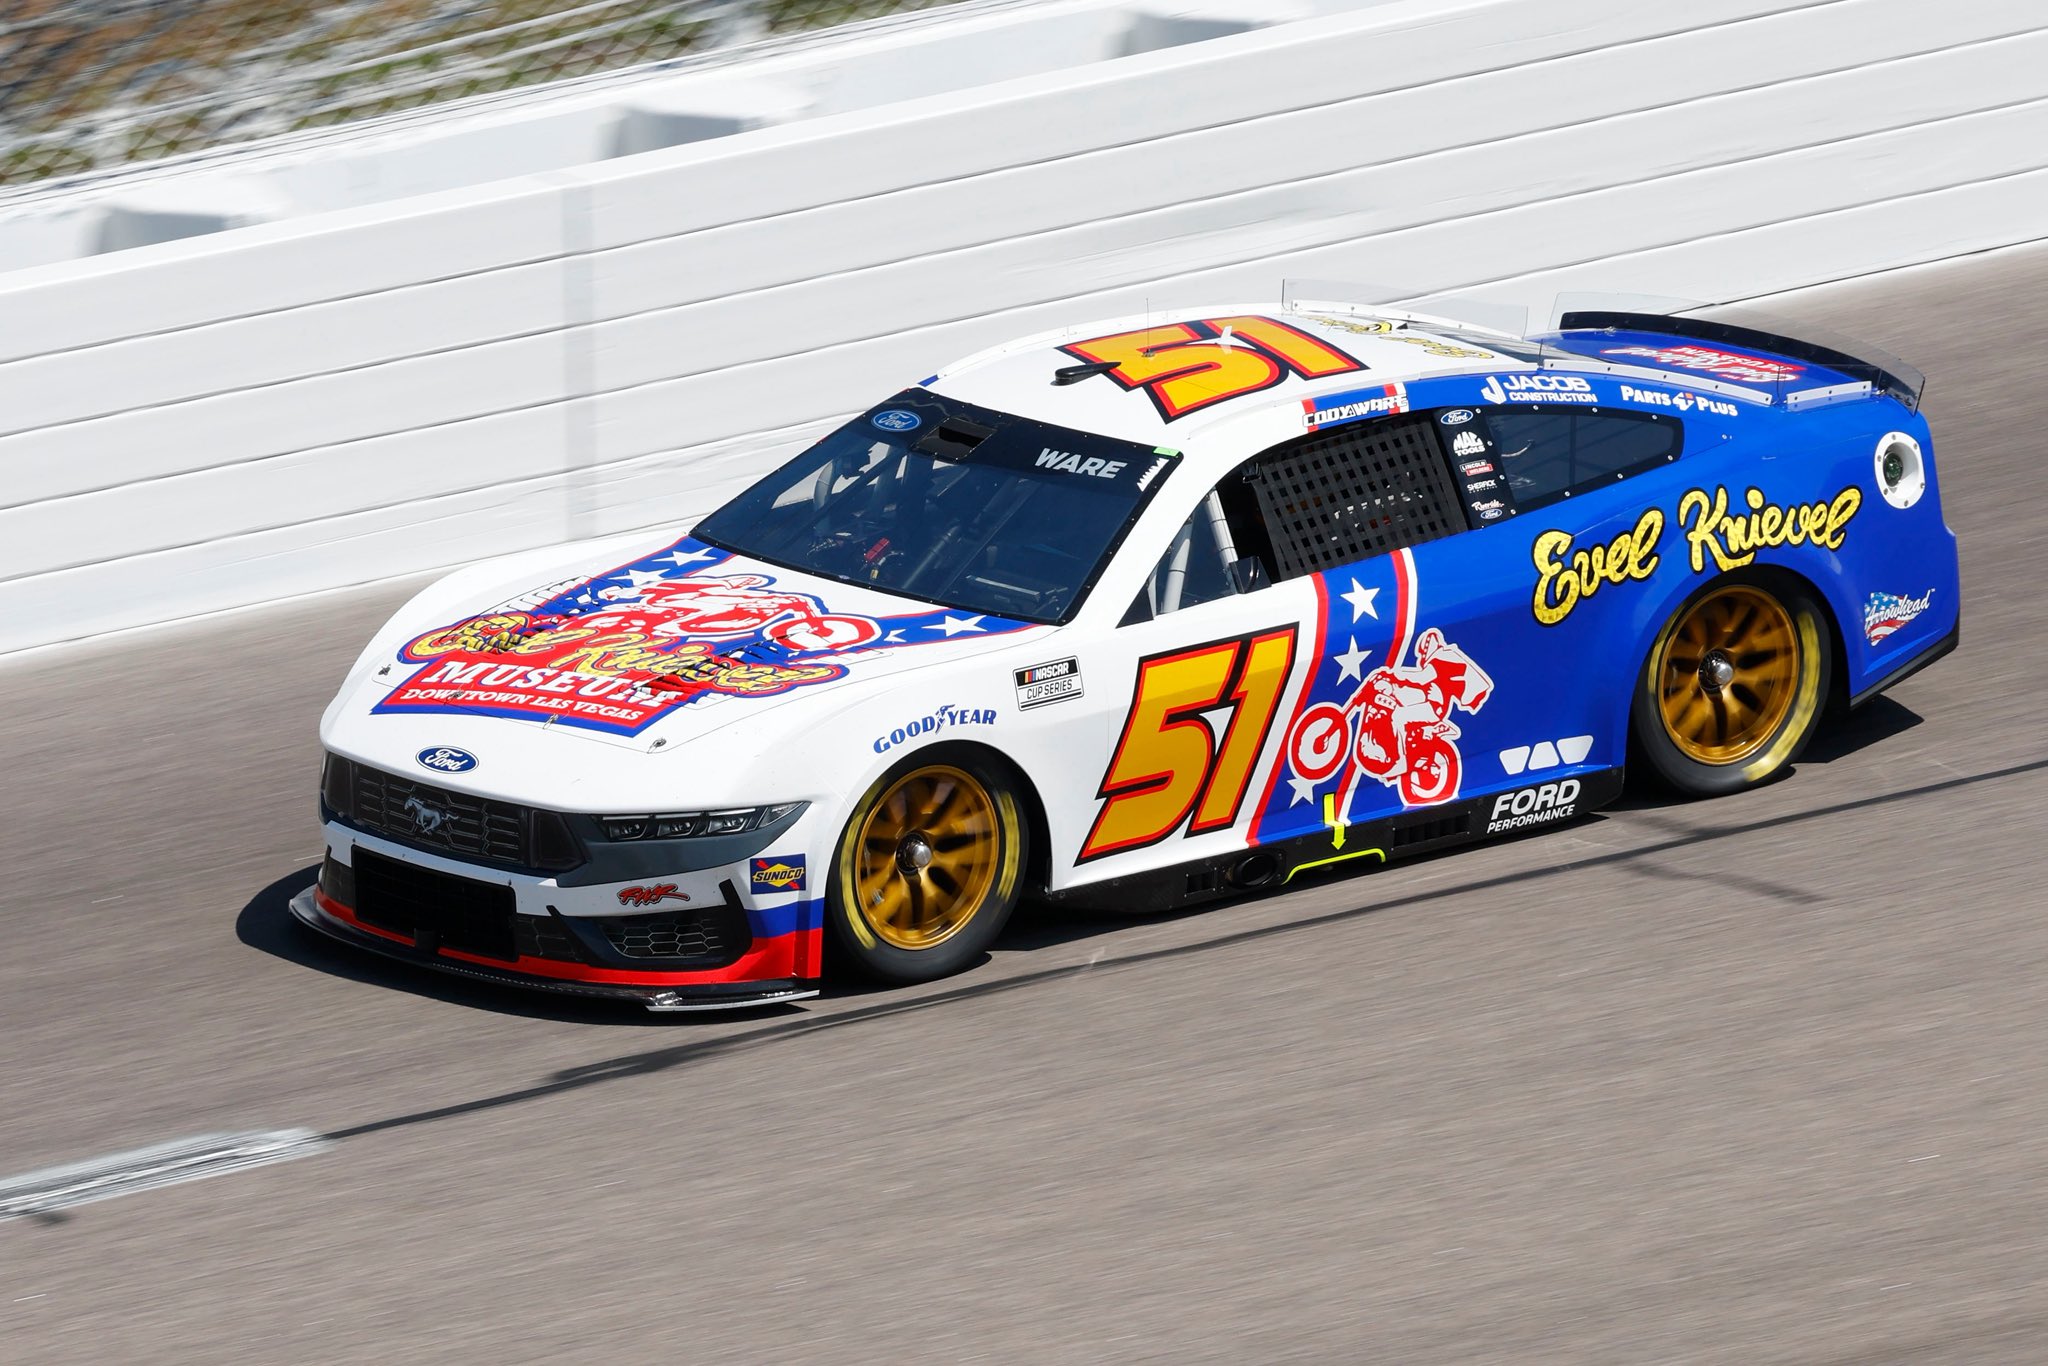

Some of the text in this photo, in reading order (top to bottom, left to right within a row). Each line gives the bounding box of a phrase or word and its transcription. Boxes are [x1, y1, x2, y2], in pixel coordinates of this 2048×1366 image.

[1054, 315, 1371, 425] 51
[1504, 375, 1592, 391] JACOB
[1508, 391, 1598, 403] CONSTRUCTION
[1620, 385, 1739, 416] PARTS PLUS
[879, 411, 916, 431] Ford
[1453, 431, 1484, 451] MAC
[1455, 445, 1486, 457] TOOLS
[1034, 447, 1127, 479] WARE
[1531, 483, 1864, 627] Evel Knievel
[1865, 590, 1931, 630] Arrowhead
[421, 661, 684, 708] MUSEUM
[1035, 662, 1069, 682] NASCAR
[1026, 678, 1073, 700] CUP SERIES
[529, 695, 574, 711] LAS
[573, 697, 645, 721] VEGAS
[873, 705, 997, 754] GOODYEAR
[1074, 623, 1300, 867] 51
[423, 748, 471, 772] Ford
[1491, 779, 1580, 821] FORD
[1486, 804, 1576, 834] PERFORMANCE
[755, 868, 803, 882] SUNOCO
